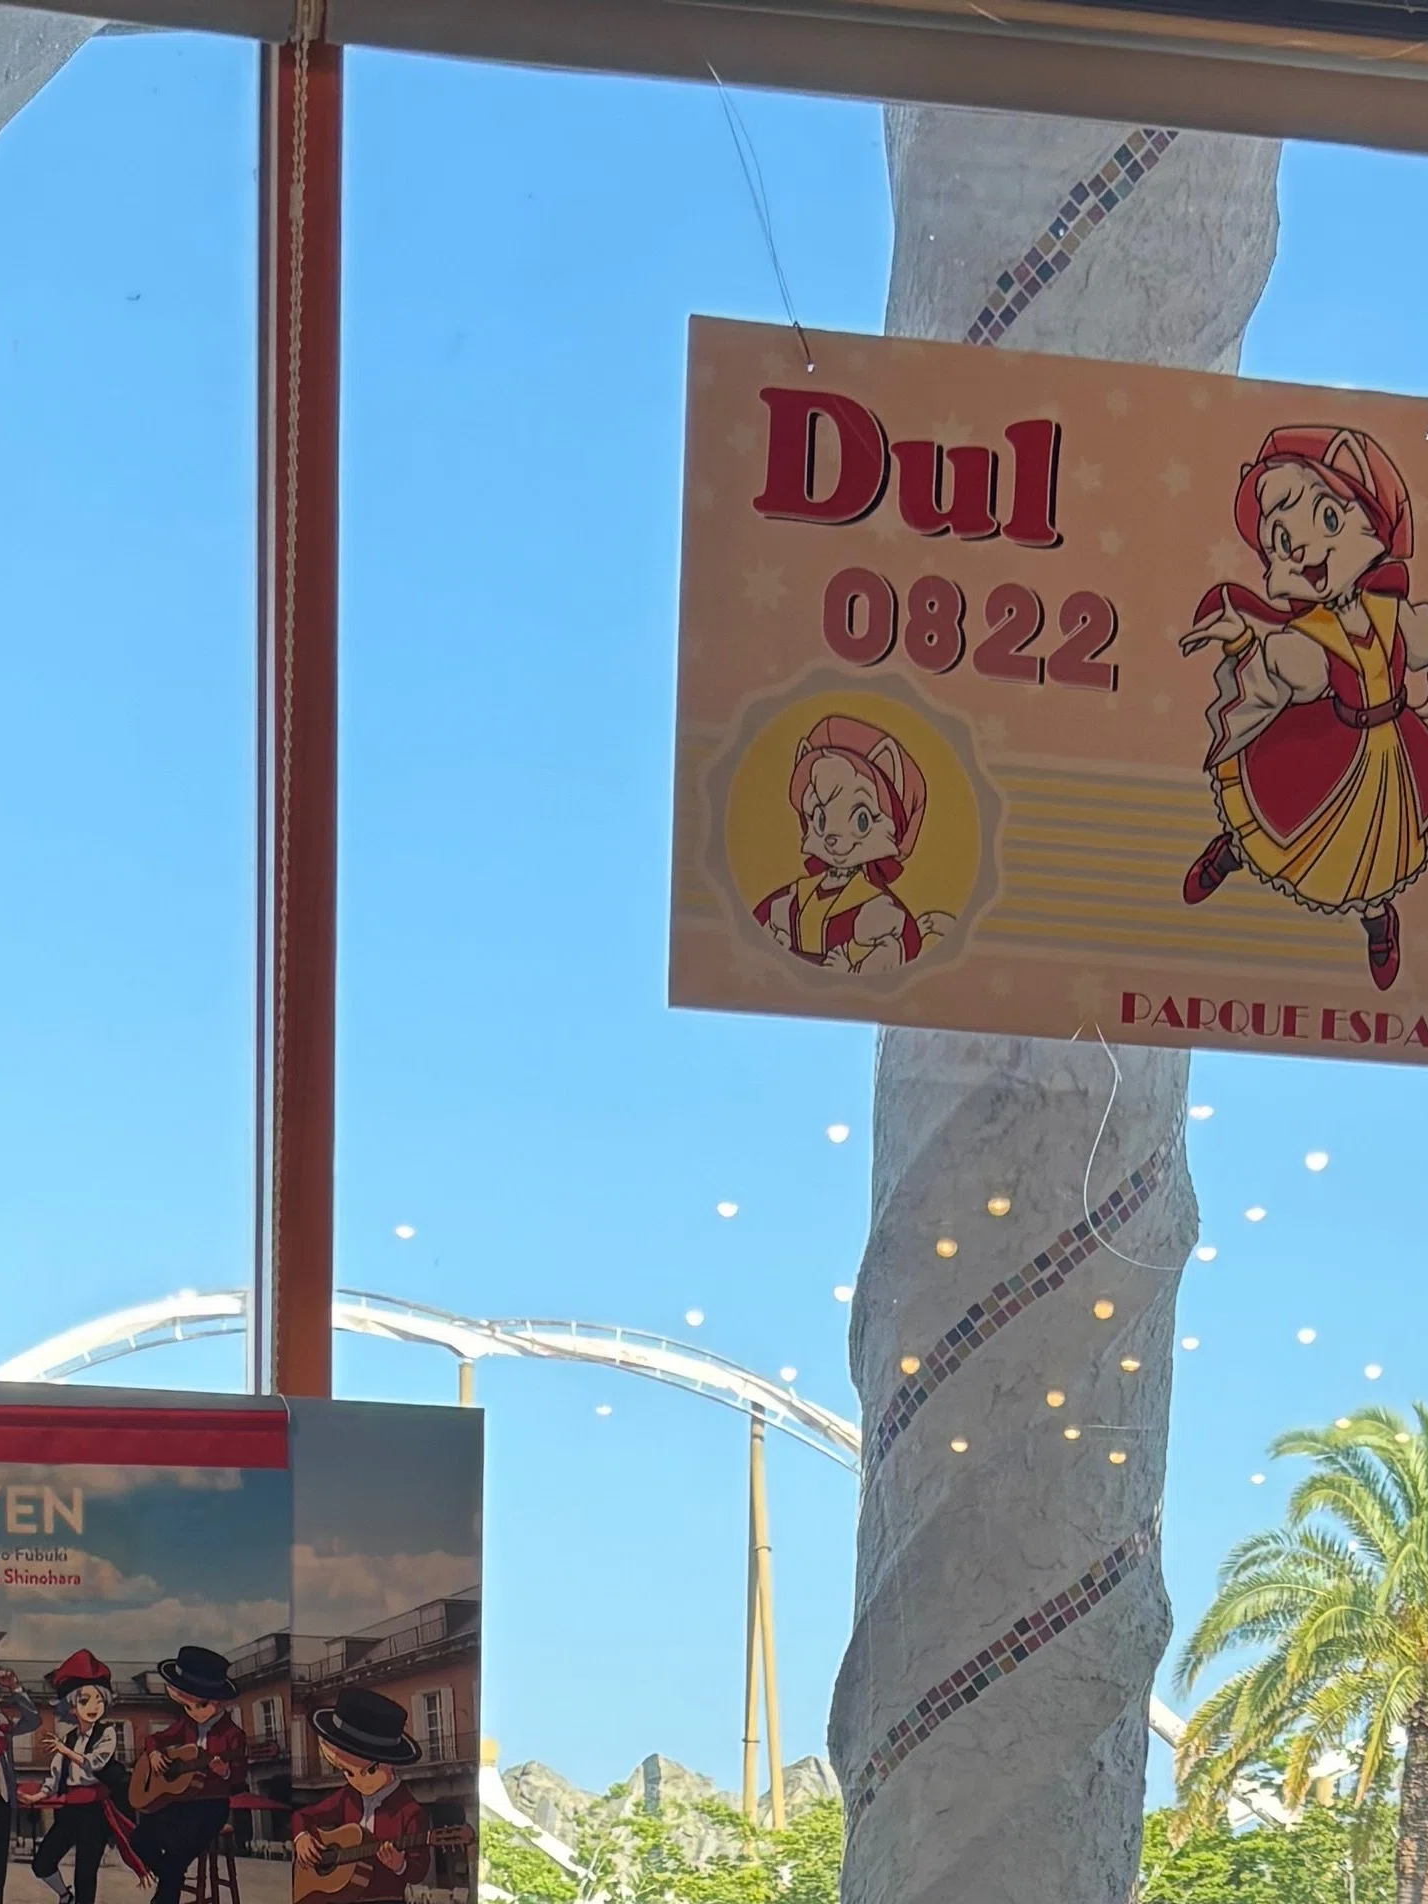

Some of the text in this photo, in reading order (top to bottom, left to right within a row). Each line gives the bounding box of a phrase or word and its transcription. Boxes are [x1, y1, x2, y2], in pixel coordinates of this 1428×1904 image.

[753, 386, 1063, 549] Dul
[823, 566, 1119, 692] 0822
[1121, 991, 1308, 1041] PARQUE
[4, 1568, 81, 1587] Shinohara
[15, 1546, 68, 1563] Fubuki
